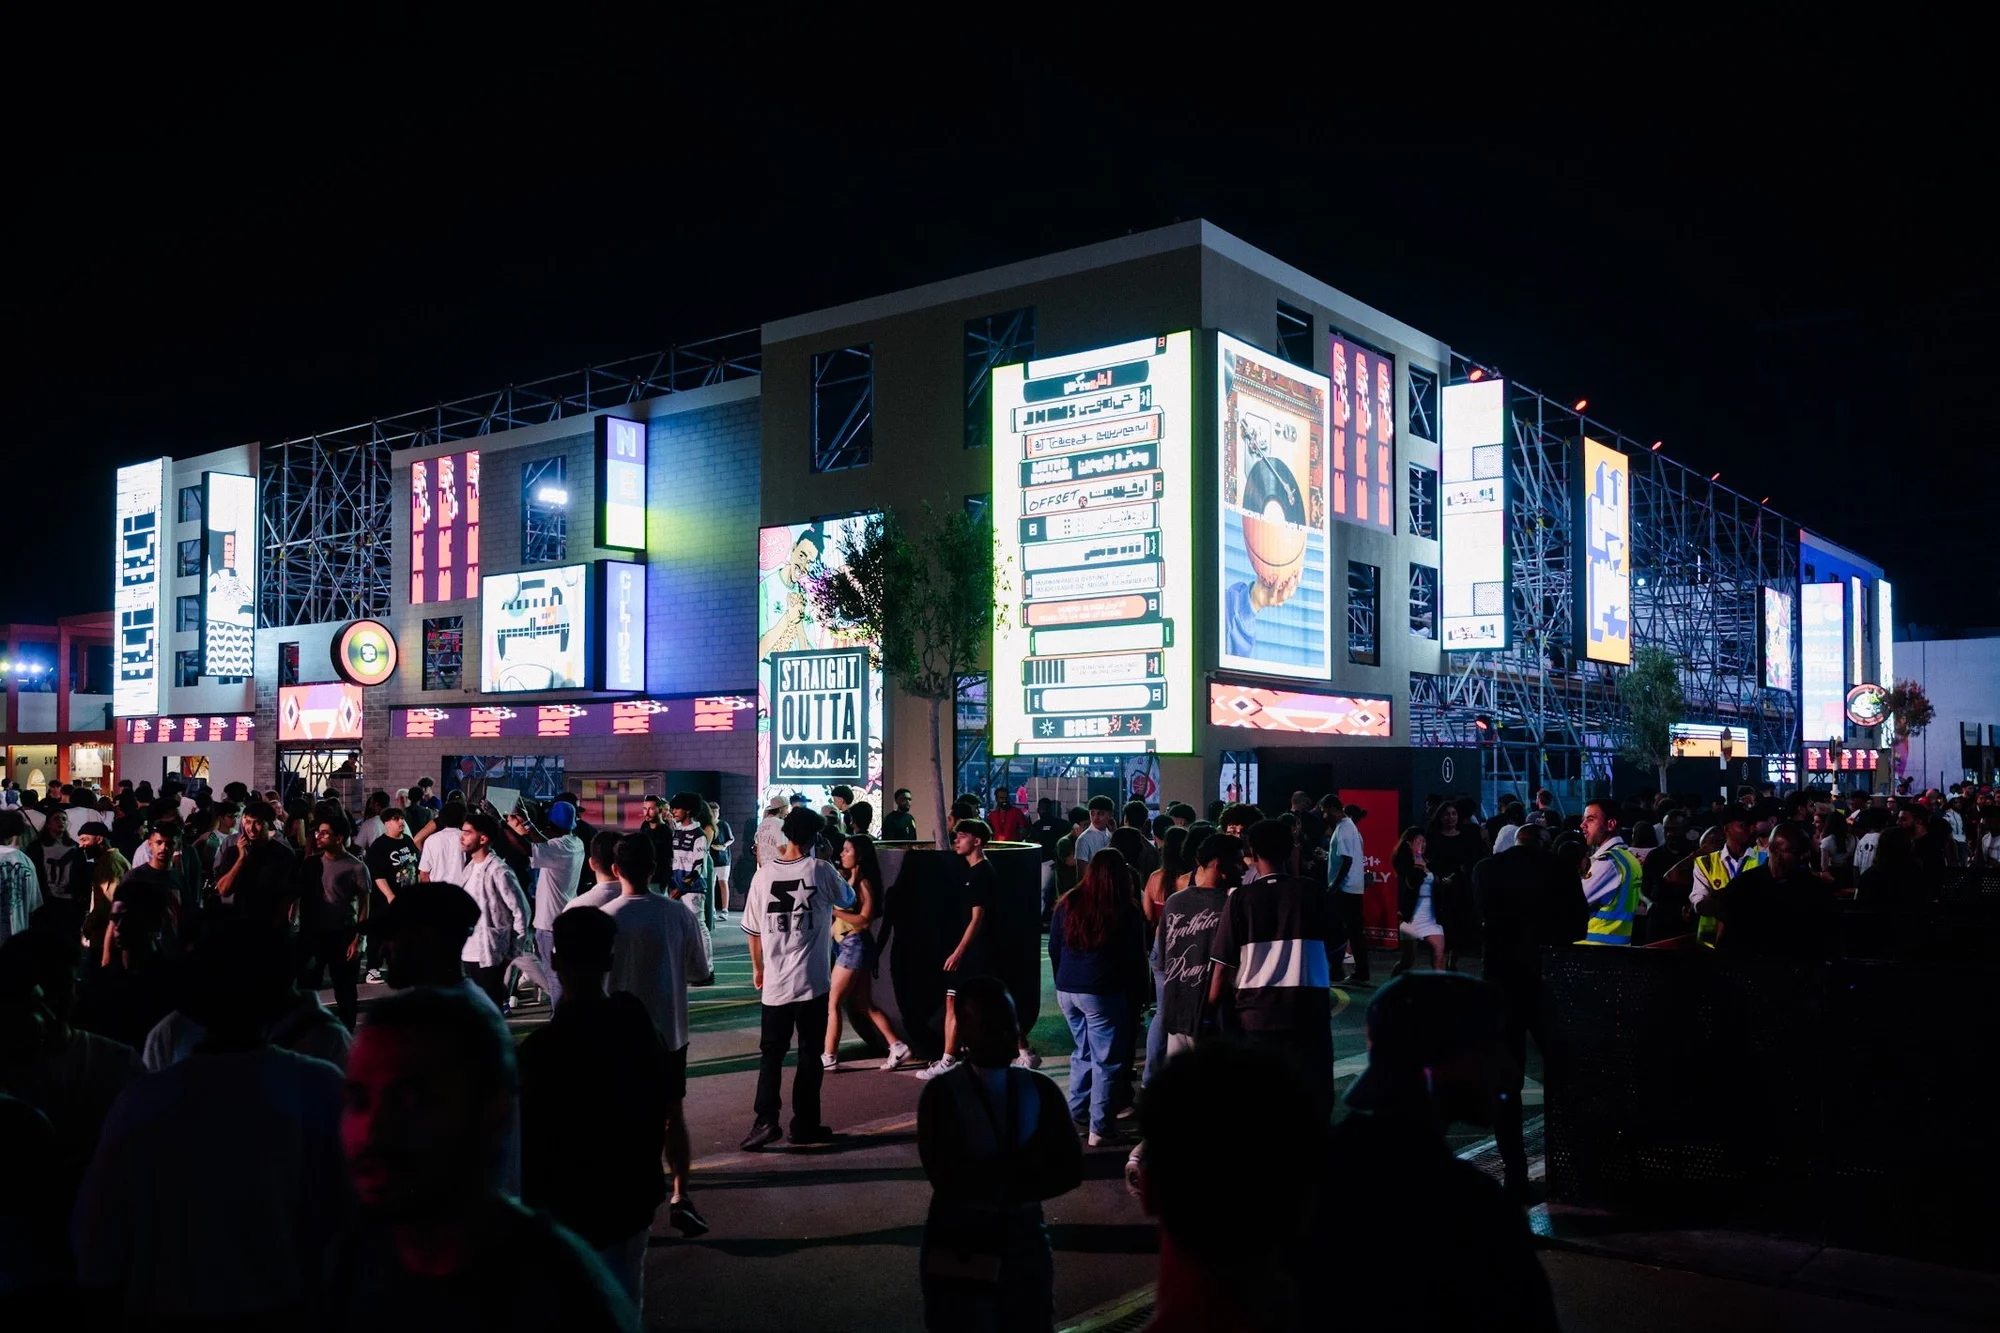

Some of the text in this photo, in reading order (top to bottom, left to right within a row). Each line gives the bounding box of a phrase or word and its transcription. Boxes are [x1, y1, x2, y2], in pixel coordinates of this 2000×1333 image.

[1029, 489, 1080, 511] OFFSET
[781, 656, 858, 691] STRAIGHT
[781, 692, 856, 742] OUTTA
[781, 748, 857, 769] Abu Dhabi
